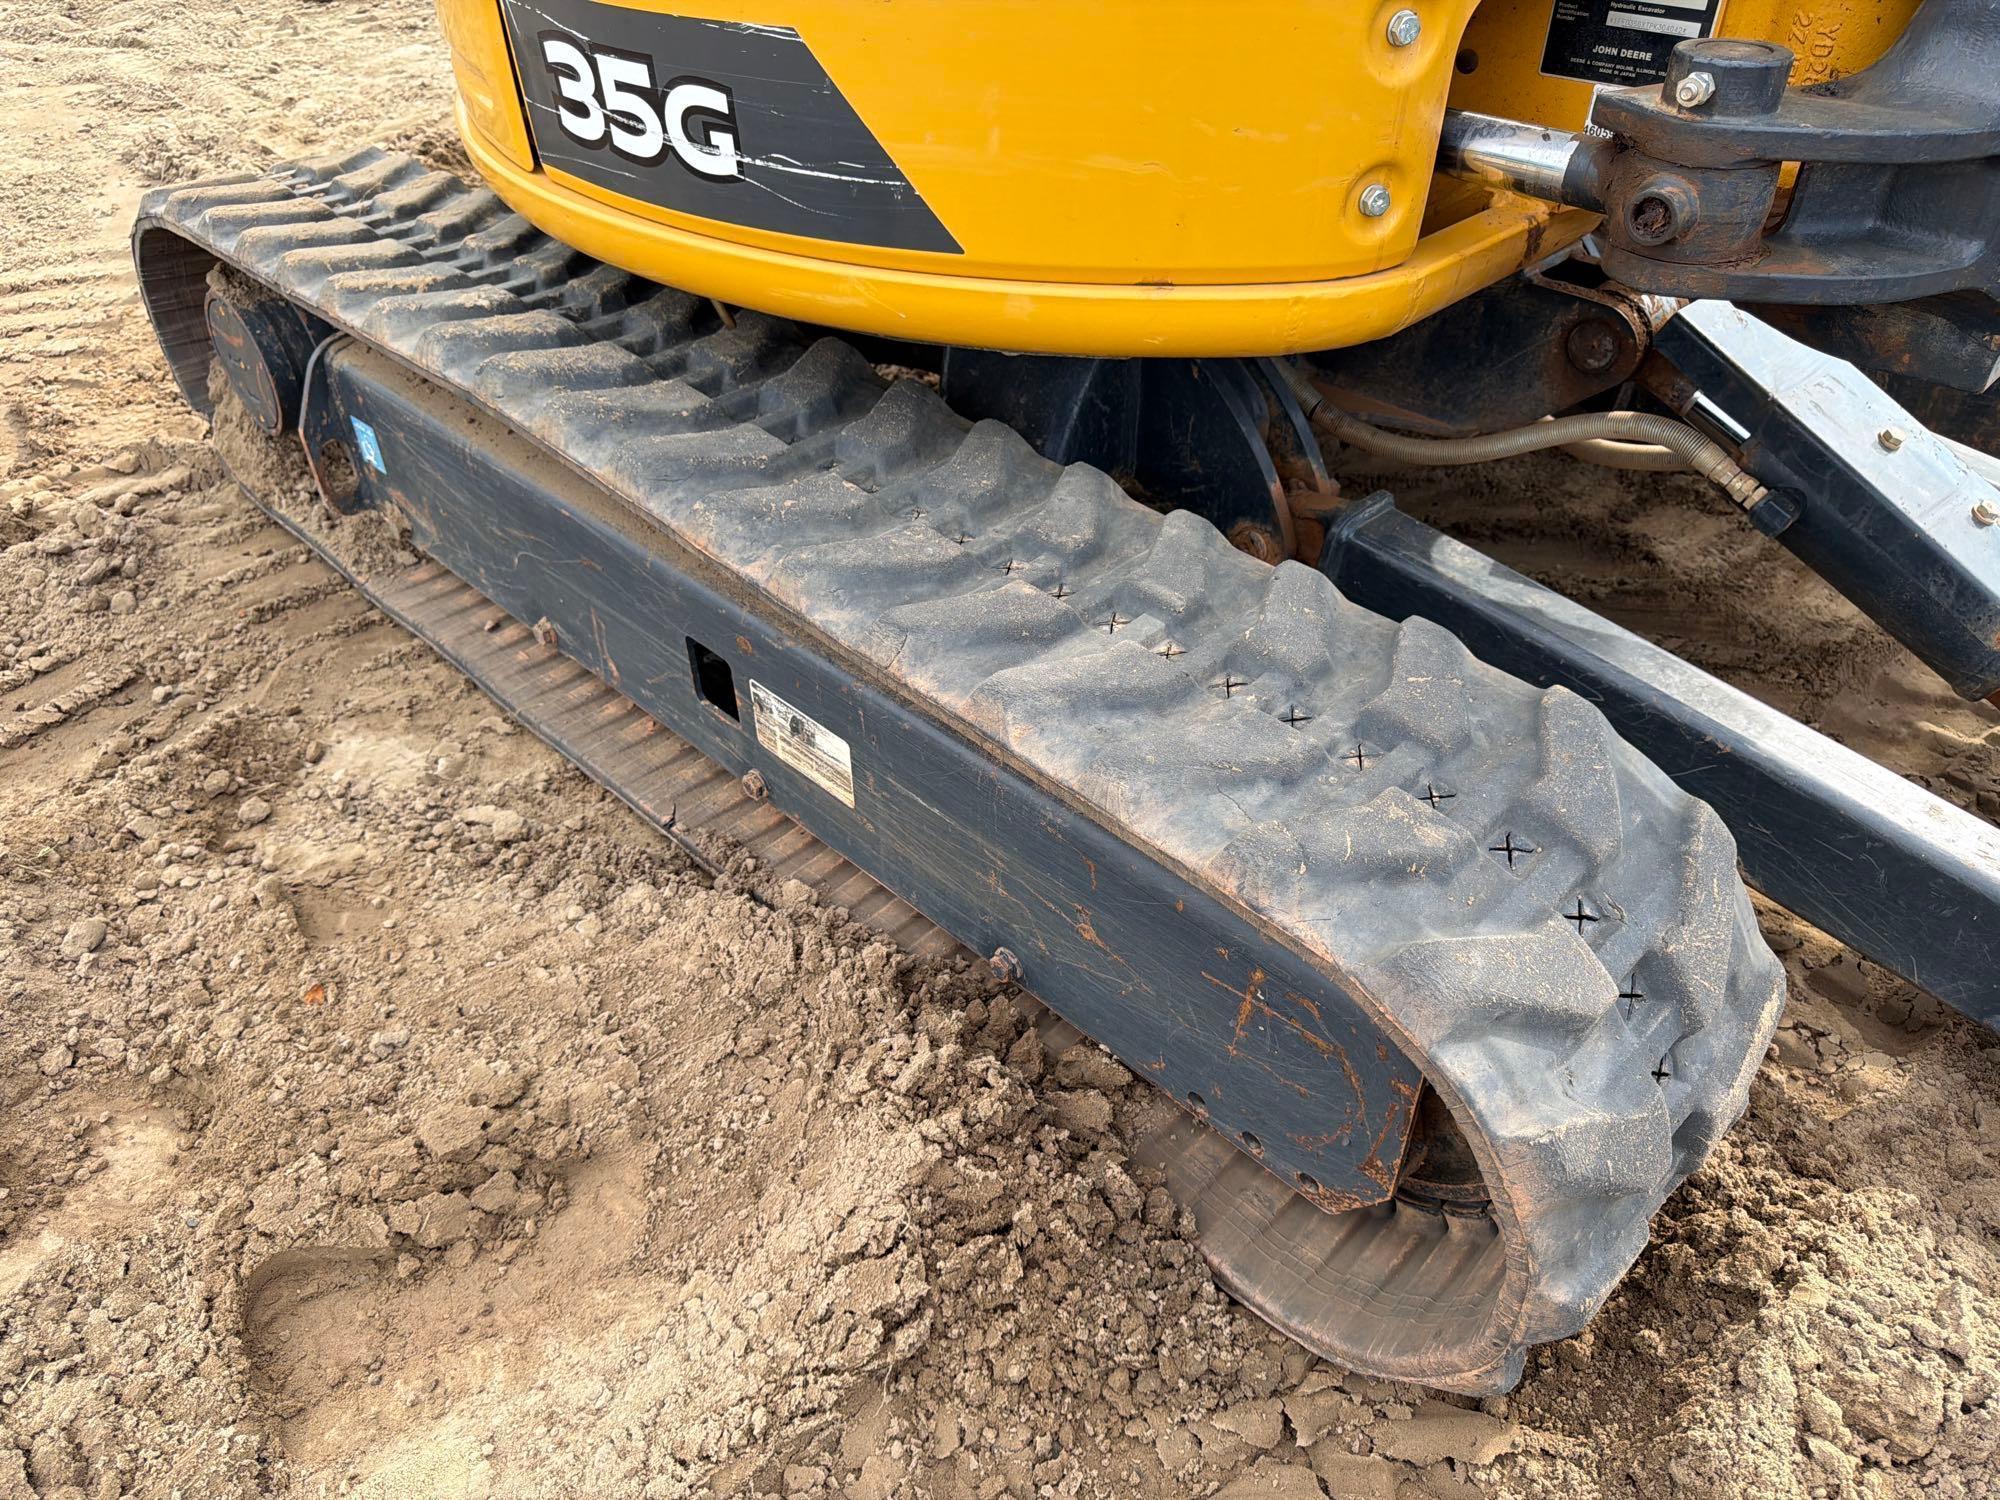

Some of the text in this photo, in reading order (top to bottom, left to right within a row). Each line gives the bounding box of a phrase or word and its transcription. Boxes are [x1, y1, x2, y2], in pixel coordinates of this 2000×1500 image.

[1610, 1, 1666, 14] Hydraulic Excavator
[1592, 45, 1653, 61] JOHN DEERE
[1570, 57, 1586, 65] DEERE
[1591, 60, 1616, 69] COMPANY
[1599, 67, 1612, 75] MADE
[539, 32, 743, 181] 35G
